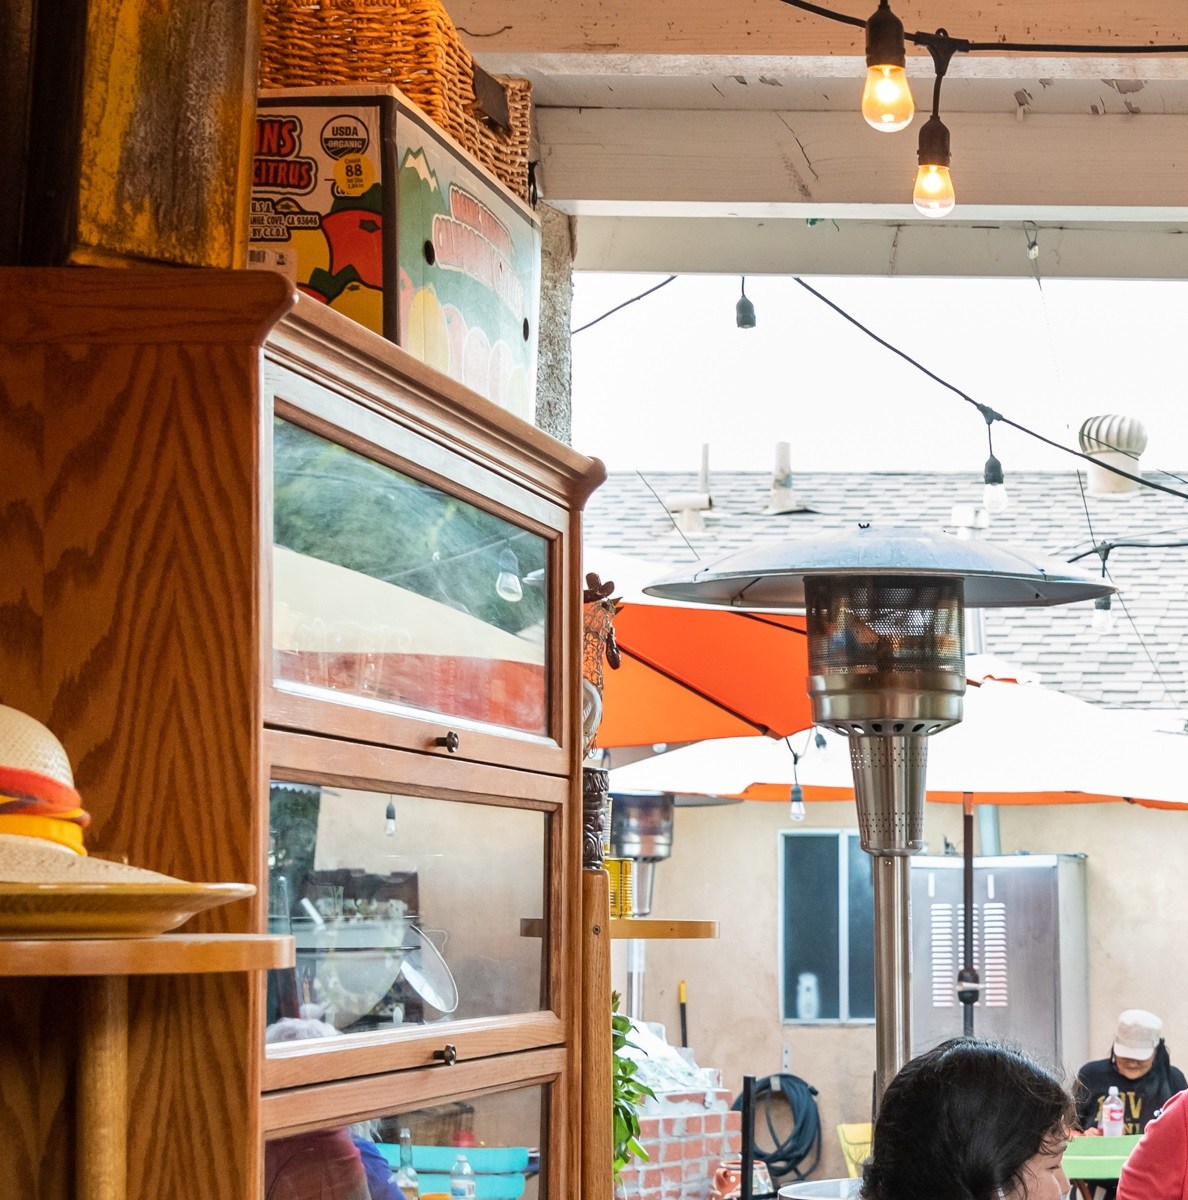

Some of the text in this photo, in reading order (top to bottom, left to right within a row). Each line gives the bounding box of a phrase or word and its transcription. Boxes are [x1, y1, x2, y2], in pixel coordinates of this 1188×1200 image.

[332, 126, 358, 137] USDA
[328, 140, 362, 149] ORGANIC
[346, 164, 363, 177] 88
[287, 216, 295, 225] CA
